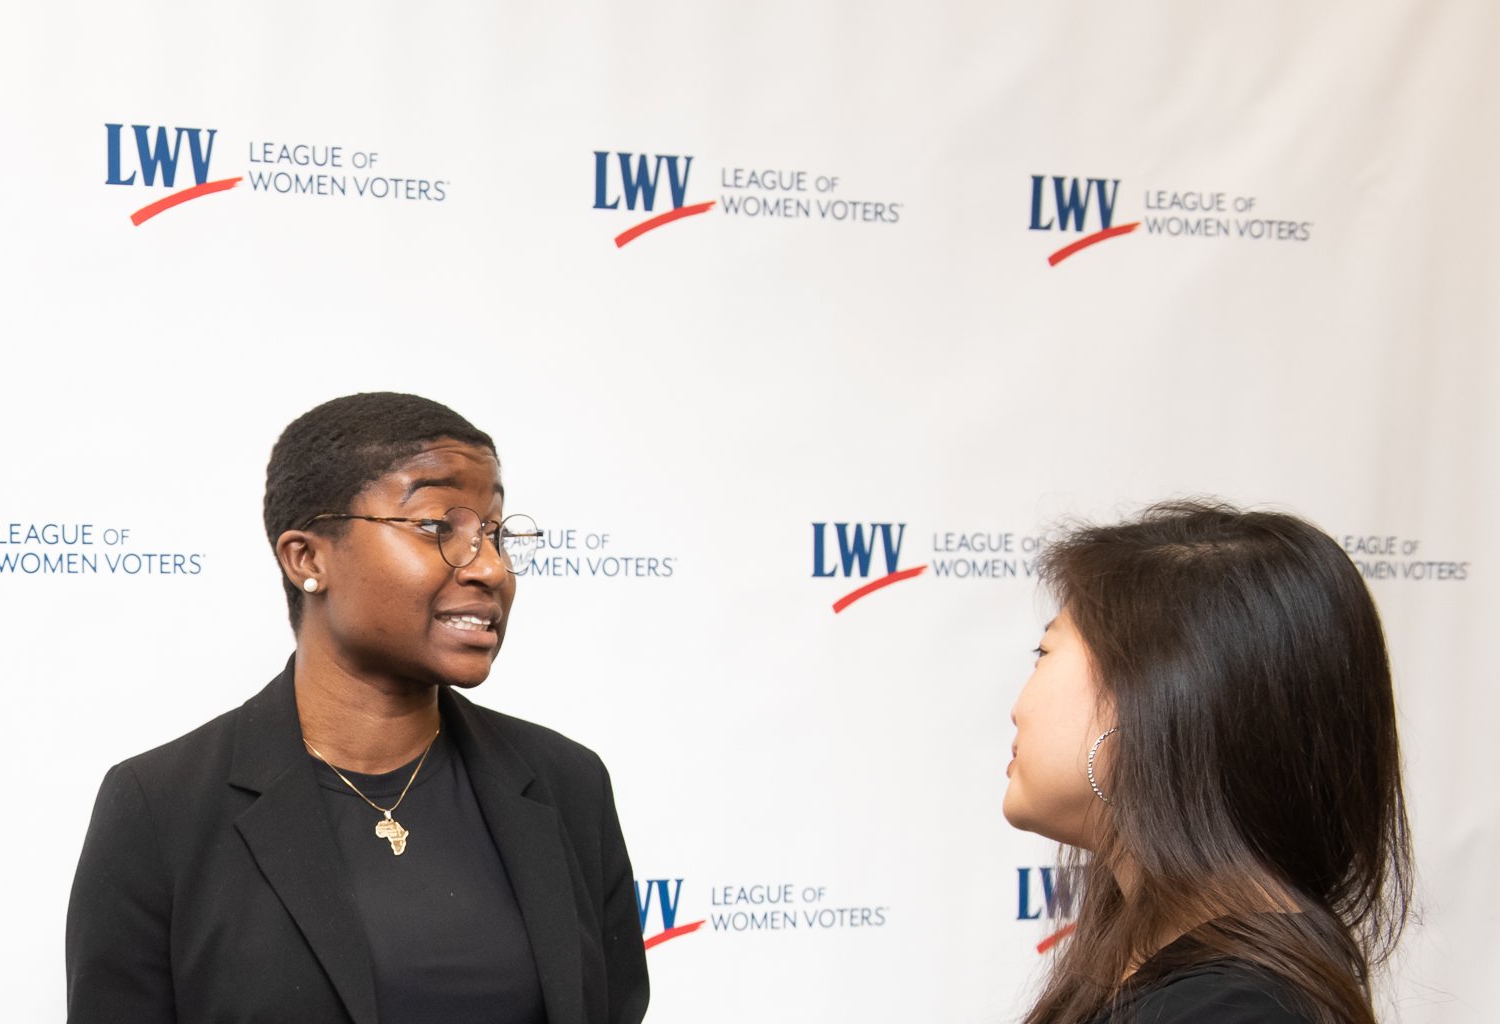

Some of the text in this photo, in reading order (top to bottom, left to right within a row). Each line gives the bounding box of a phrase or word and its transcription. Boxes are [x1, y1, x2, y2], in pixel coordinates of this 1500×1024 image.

[104, 123, 218, 189] LWV
[250, 142, 377, 168] LEAGUE OF
[249, 171, 445, 201] WOMEN VOTERS
[592, 151, 695, 213] LWV
[721, 169, 837, 192] LEAGUE OF
[721, 196, 898, 222] WOMEN VOTERS
[1028, 174, 1122, 234] LWV
[1146, 191, 1254, 213] LEAGUE OF
[1146, 218, 1309, 241] WOMEN VOTERS
[104, 529, 129, 545] OF
[586, 535, 609, 549] OF
[934, 533, 1012, 553] LEAGUE
[1343, 535, 1419, 555] EAGUE OF
[812, 522, 907, 579] LWV
[105, 554, 201, 574] VOTERS
[587, 557, 672, 577] VOTERS
[933, 558, 1016, 578] WOMEN
[1361, 561, 1467, 580] OMEN VOTERS
[711, 885, 823, 905] LEAGUE OF
[711, 907, 884, 931] WOMEN VOTERS
